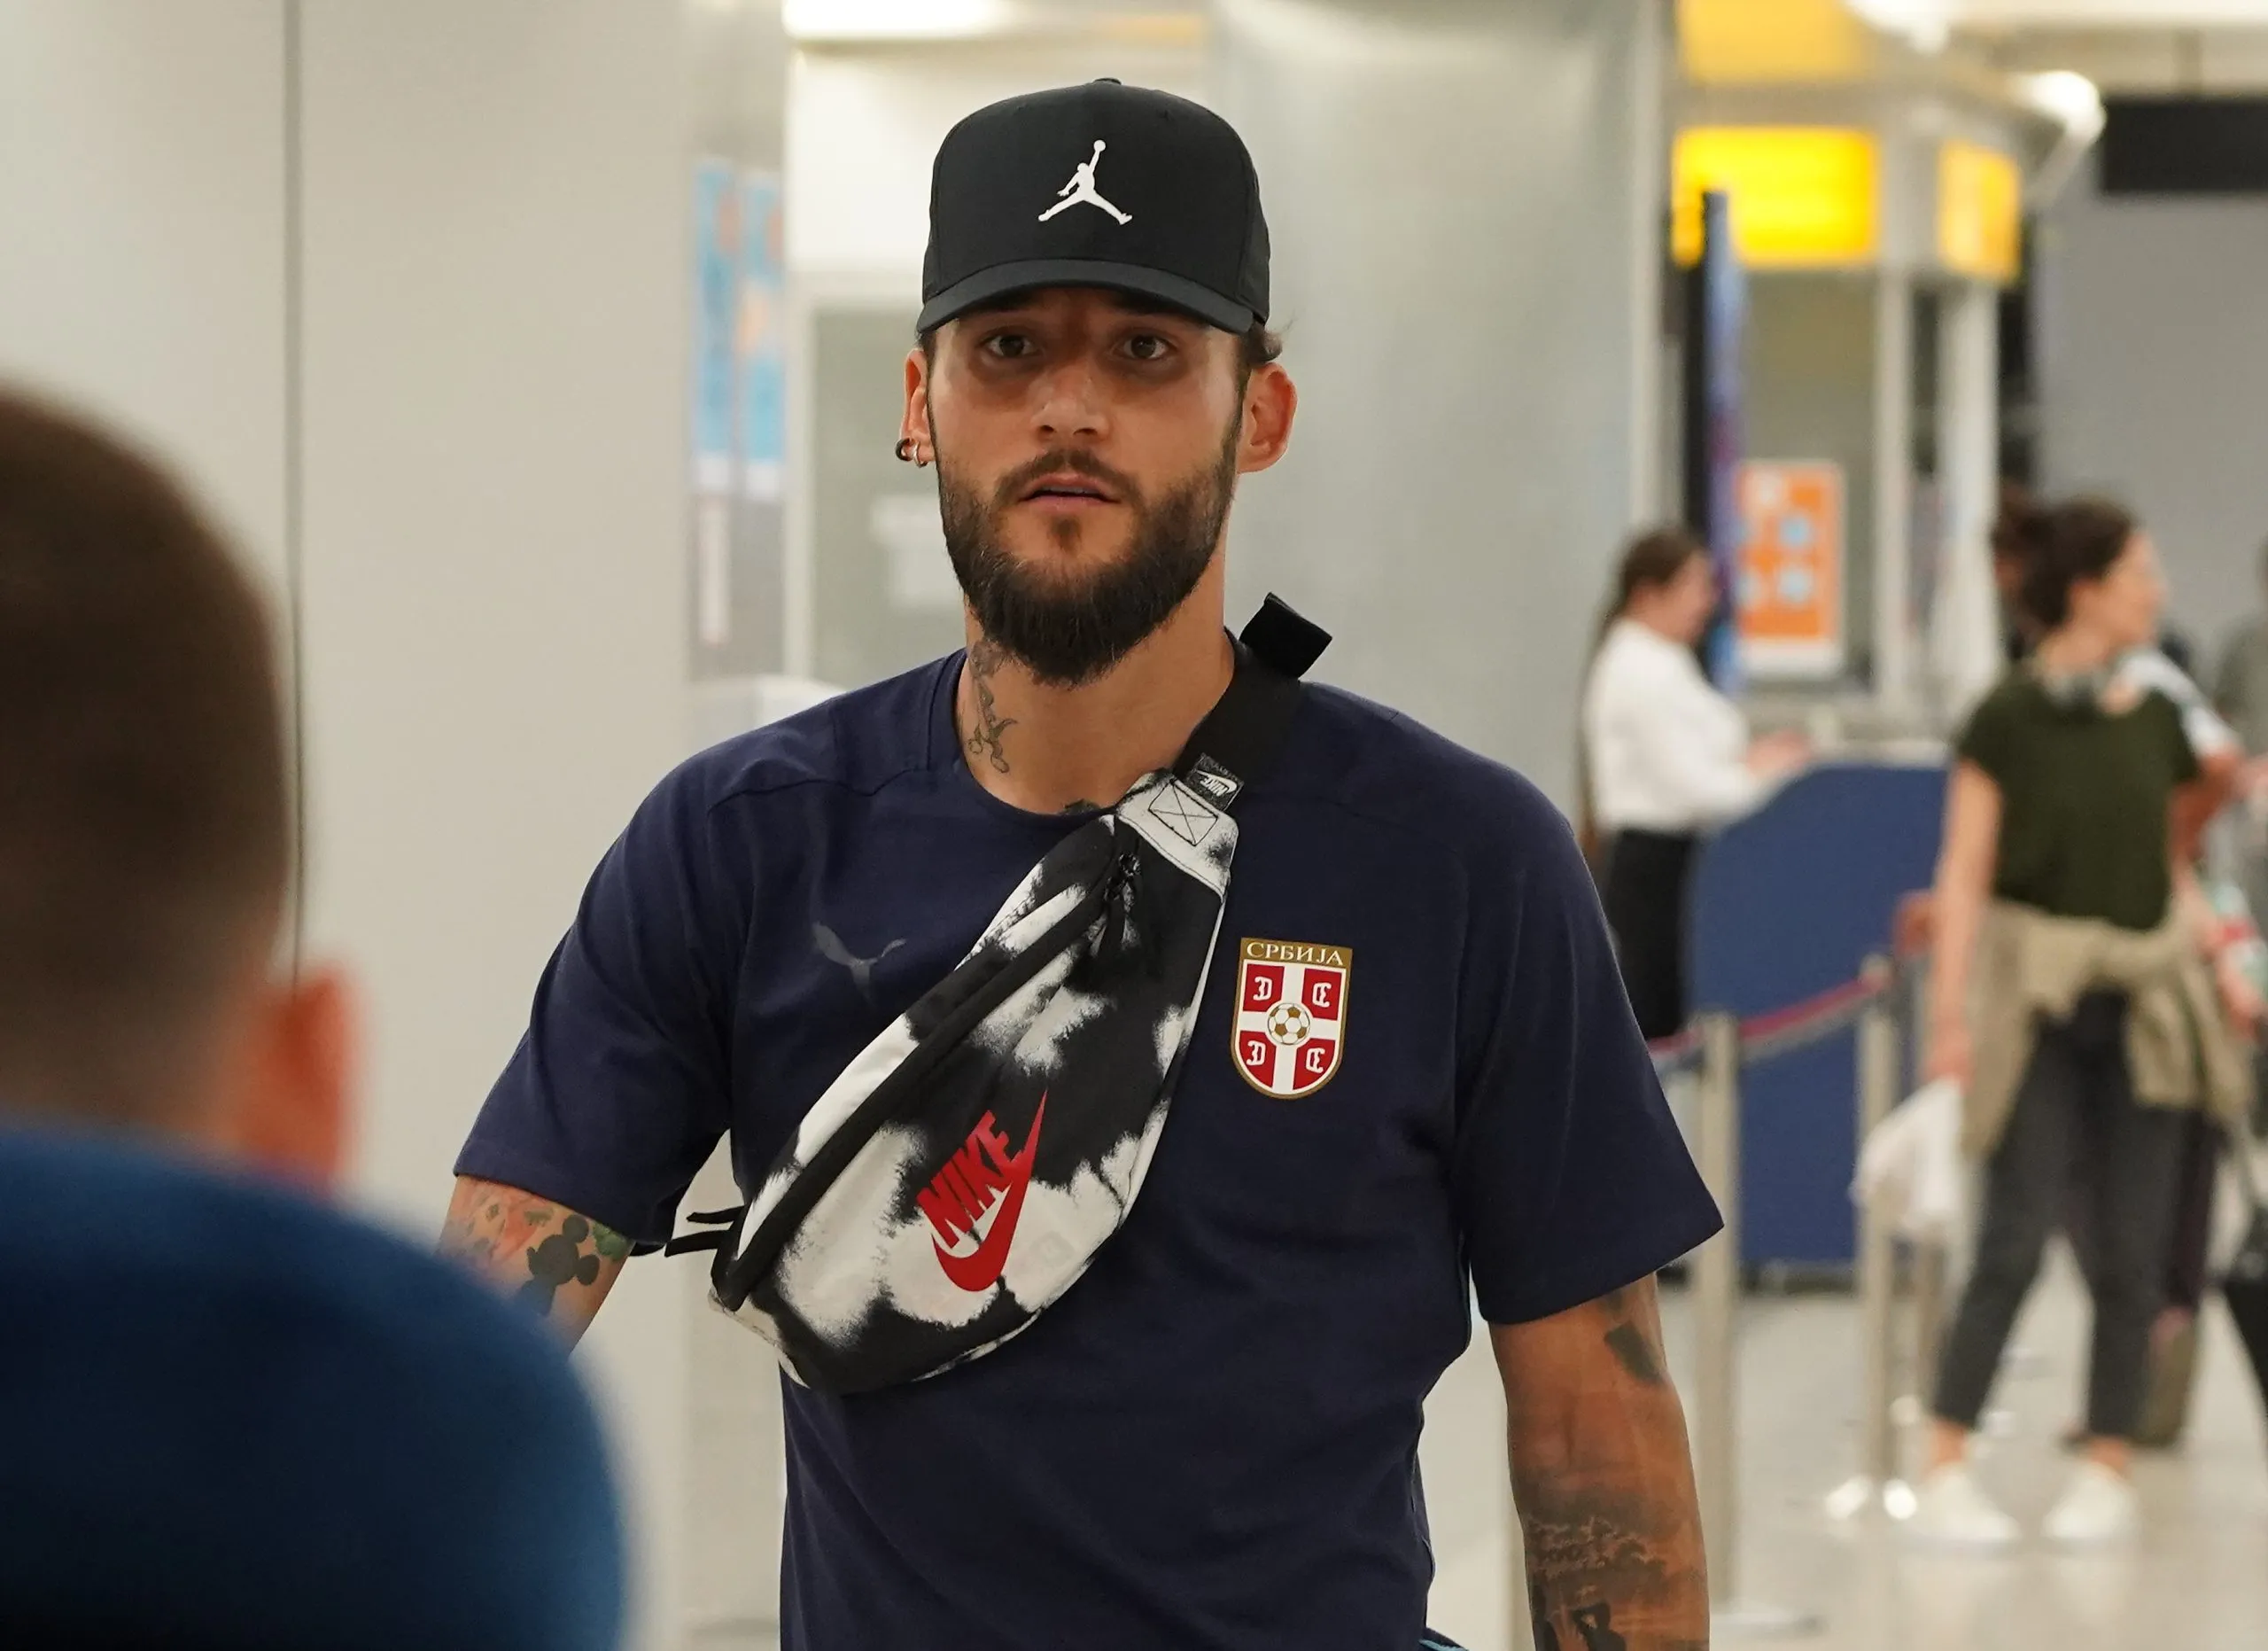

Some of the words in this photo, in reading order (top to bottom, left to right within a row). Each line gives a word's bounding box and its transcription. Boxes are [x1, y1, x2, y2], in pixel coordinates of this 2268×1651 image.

[1200, 777, 1229, 797] NIKE
[1247, 942, 1344, 965] СРБИЈА
[916, 1110, 1023, 1249] NIKE
